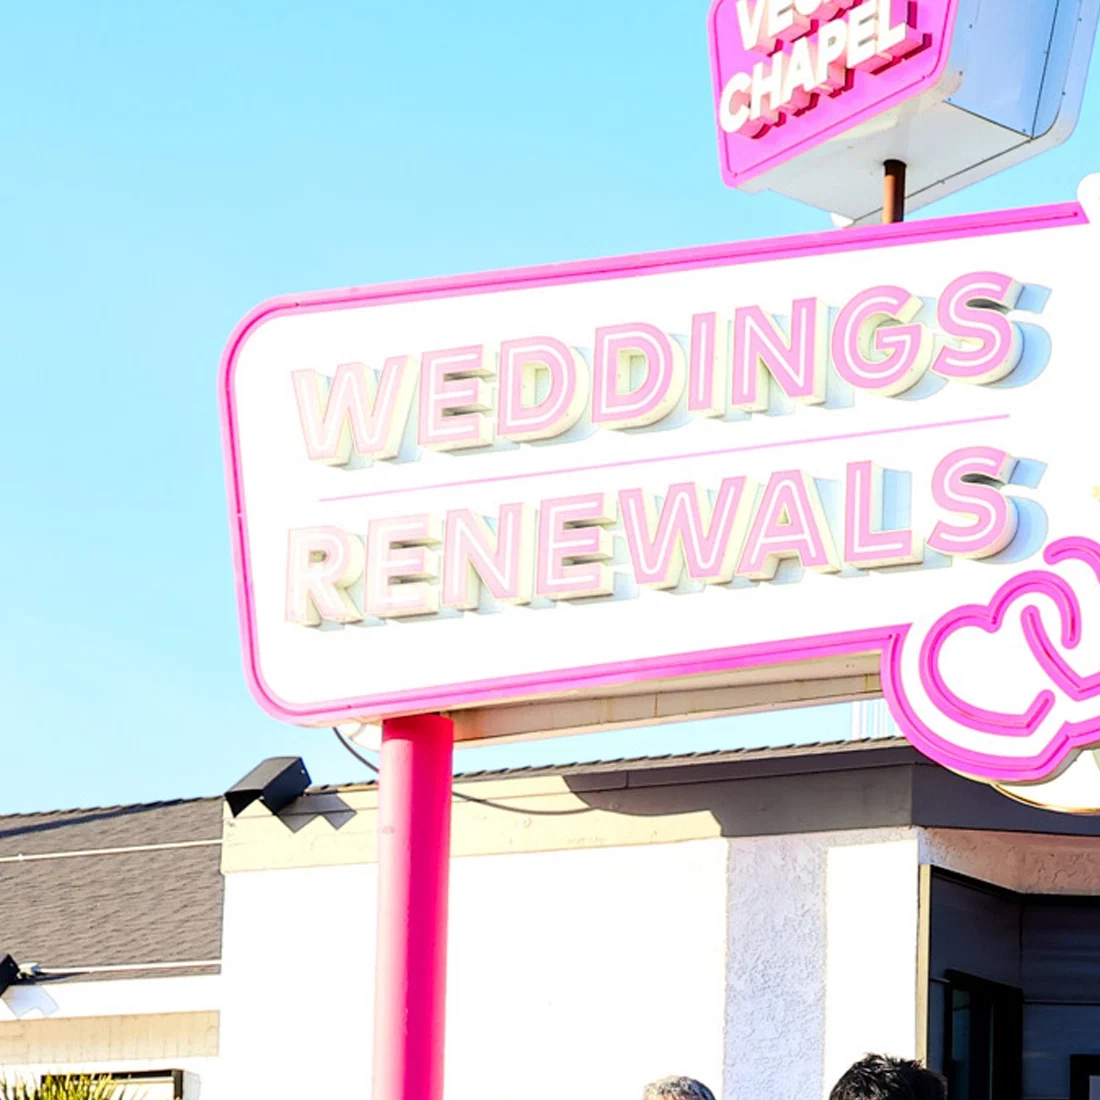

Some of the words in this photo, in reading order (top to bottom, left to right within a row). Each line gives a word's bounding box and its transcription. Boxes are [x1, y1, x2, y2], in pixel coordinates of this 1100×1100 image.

[719, 0, 906, 133] CHAPEL
[291, 271, 1026, 466] WEDDINGS
[285, 446, 1020, 627] RENEWALS
